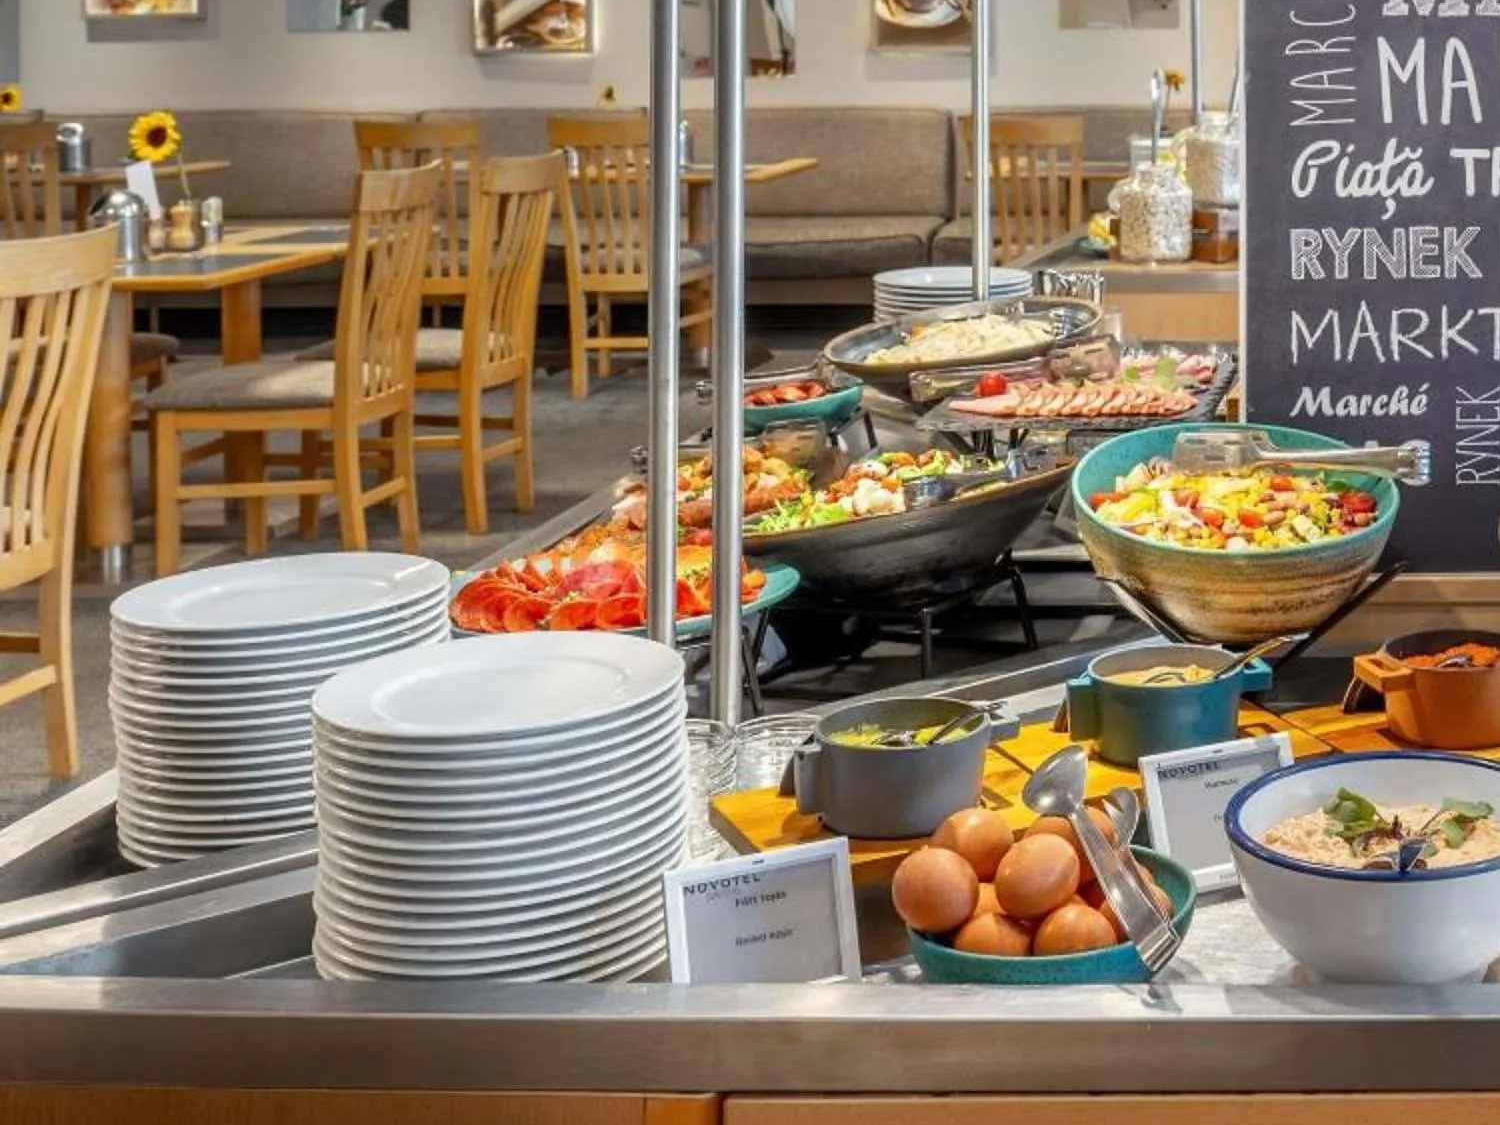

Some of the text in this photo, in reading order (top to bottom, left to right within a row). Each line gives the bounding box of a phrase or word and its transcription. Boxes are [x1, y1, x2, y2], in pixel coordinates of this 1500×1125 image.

[1288, 225, 1484, 280] RYNEK
[1289, 381, 1431, 418] Marché
[683, 872, 762, 897] NOVOTEL
